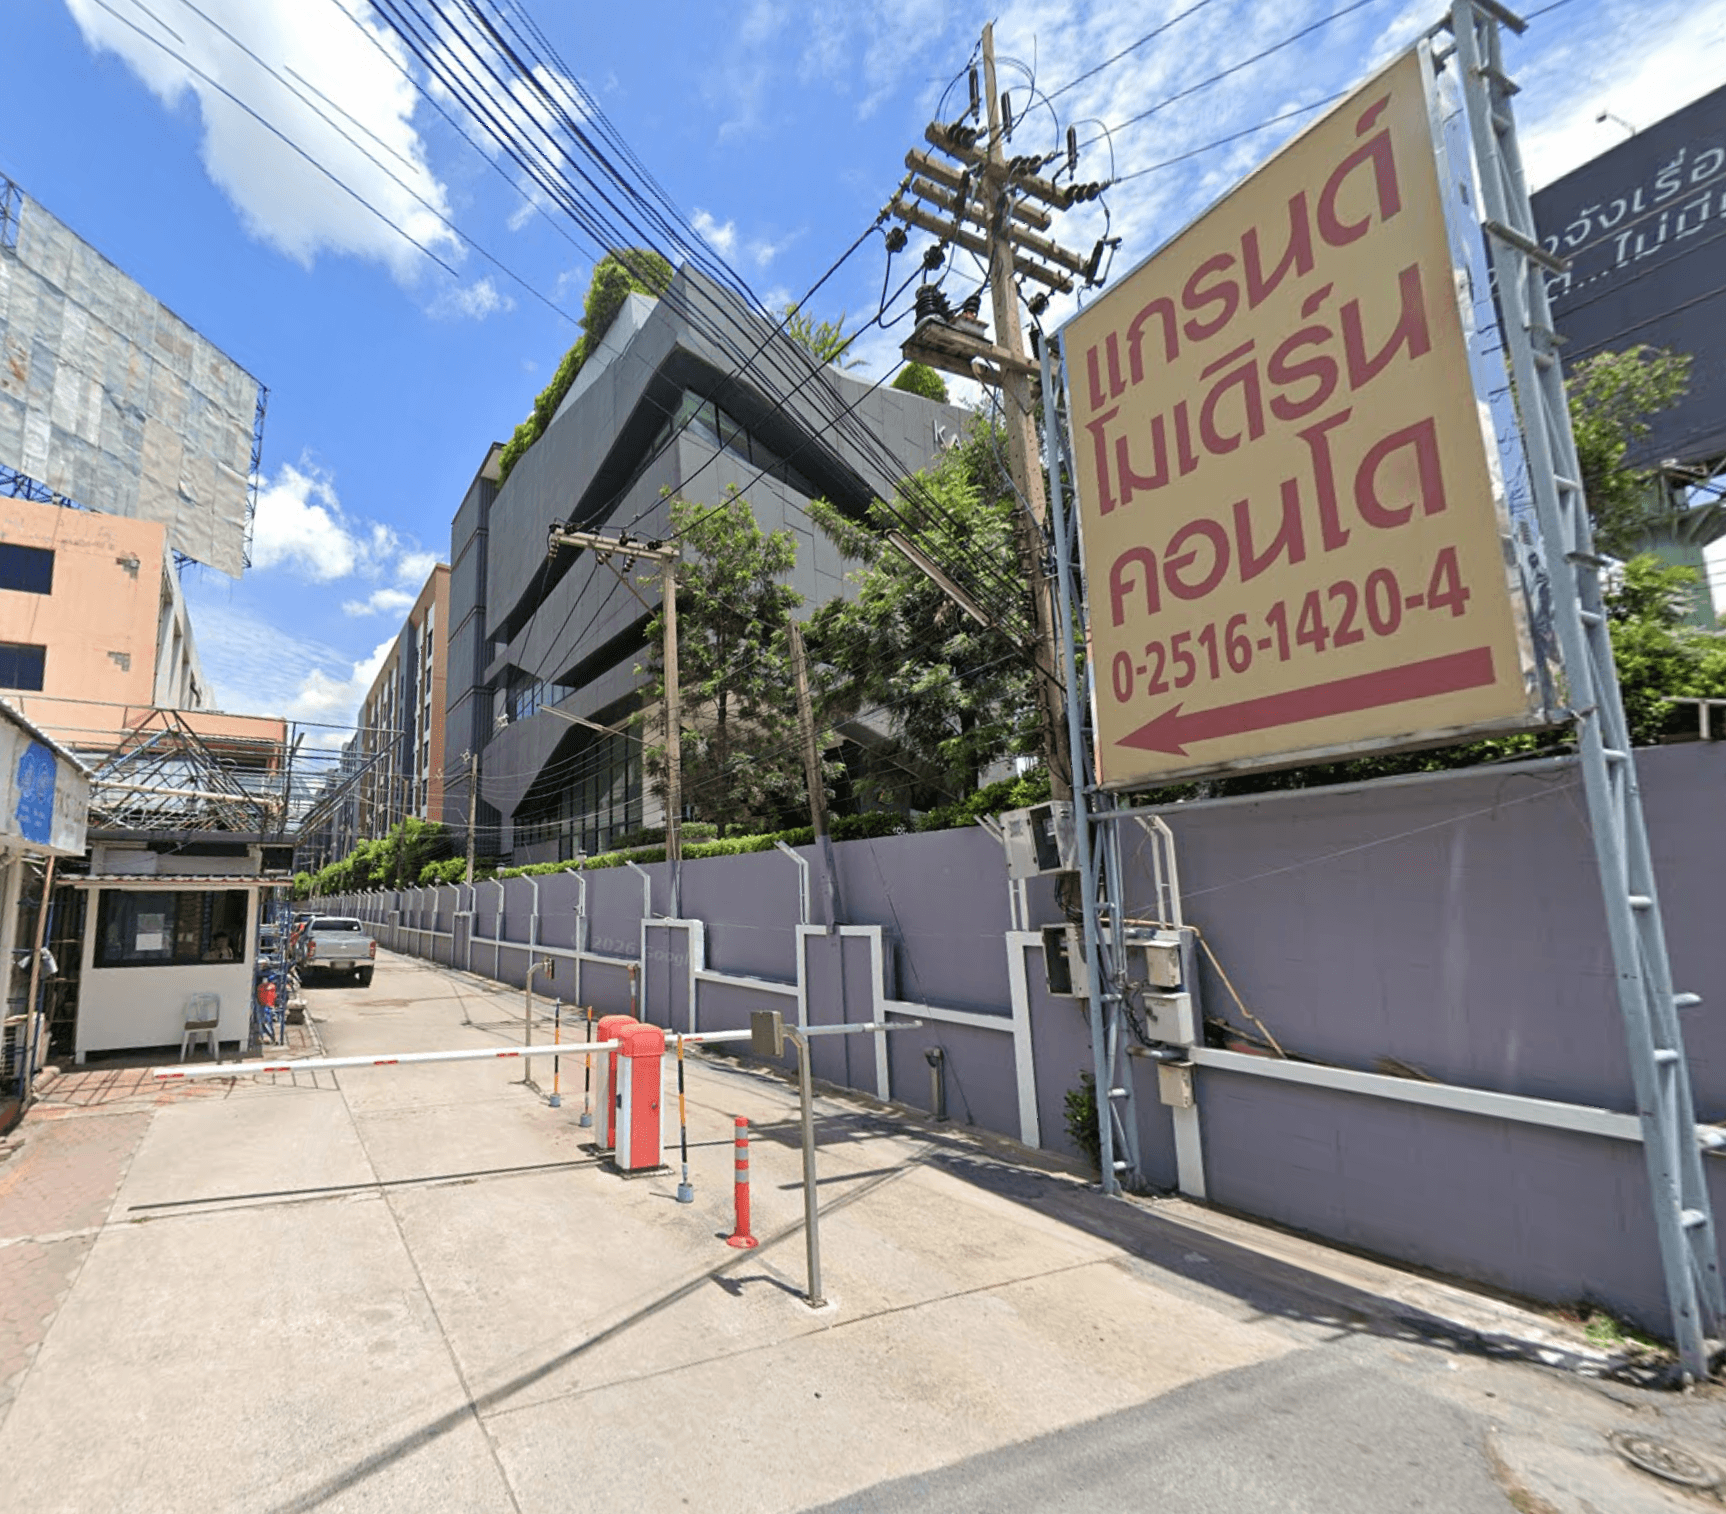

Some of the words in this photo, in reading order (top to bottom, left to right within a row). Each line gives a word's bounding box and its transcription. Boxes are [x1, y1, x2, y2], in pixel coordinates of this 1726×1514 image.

[1086, 95, 1401, 412] แกรนด์
[1085, 265, 1431, 516] โมเดิร์น
[1109, 407, 1447, 628] คอนโด
[1111, 546, 1471, 704] 0-2516-1420-4
